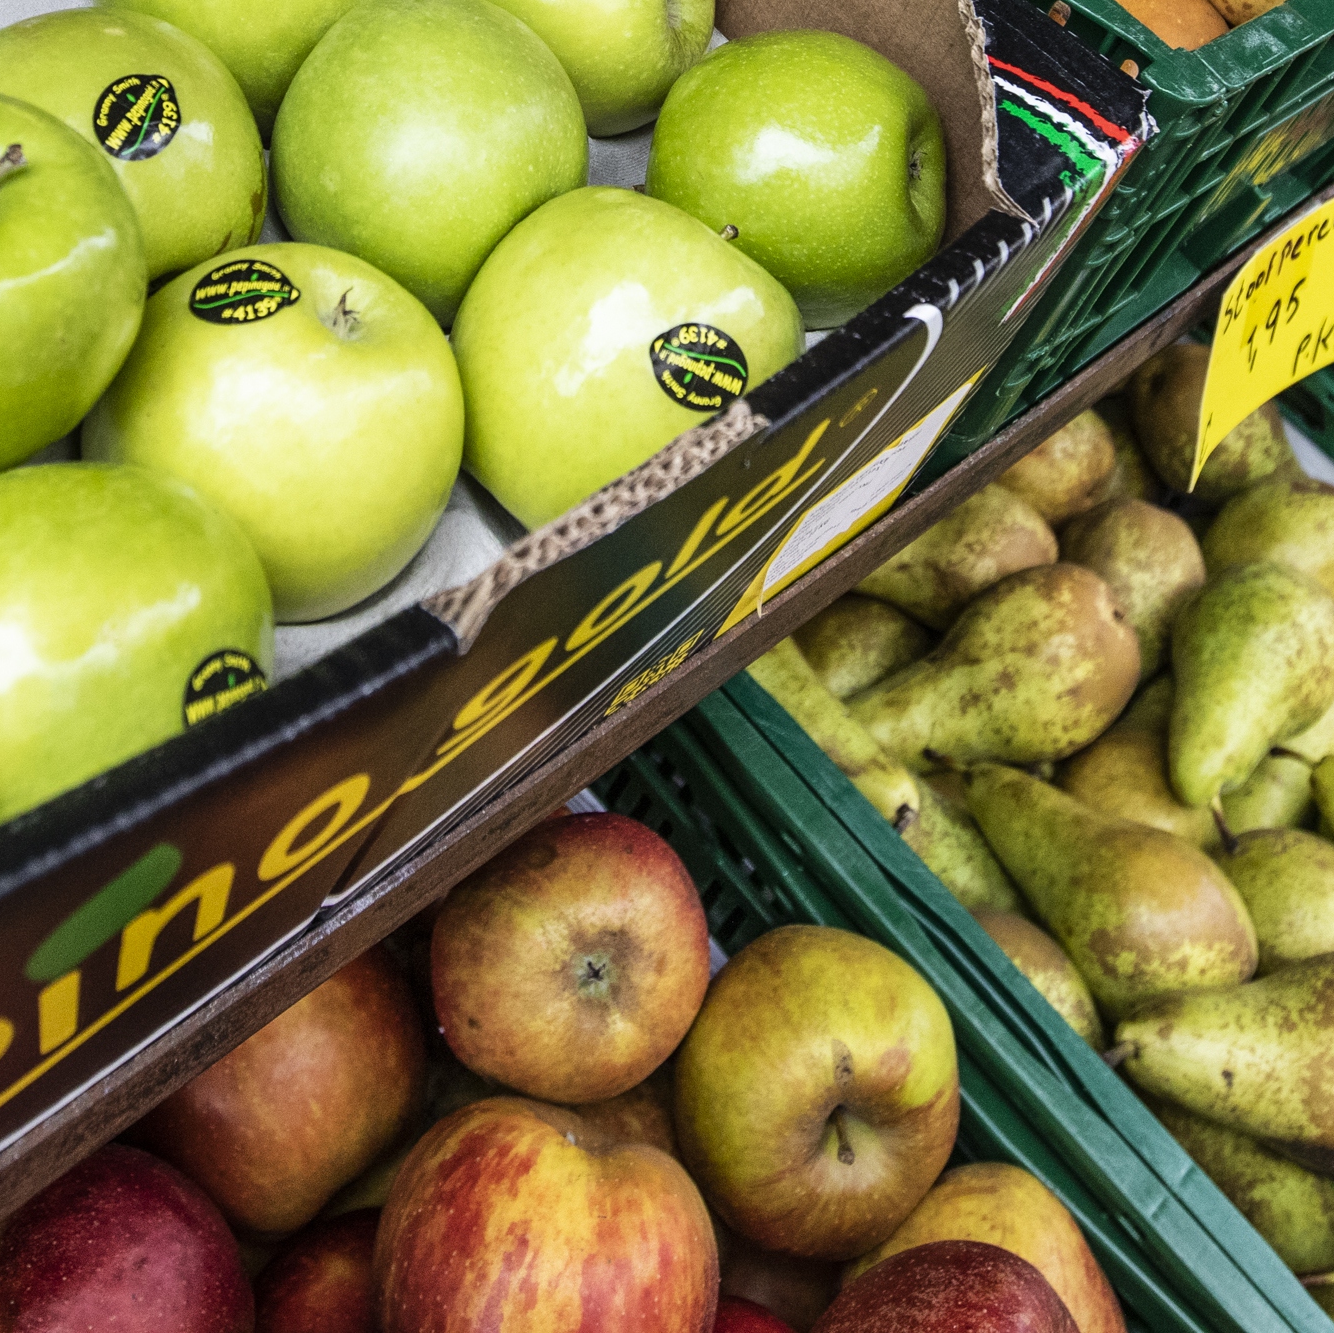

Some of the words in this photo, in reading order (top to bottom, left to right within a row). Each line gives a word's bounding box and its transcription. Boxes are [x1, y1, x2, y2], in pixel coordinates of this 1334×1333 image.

[96, 93, 117, 127] Granny
[112, 77, 141, 94] Smith
[211, 262, 250, 281] Granny
[251, 262, 282, 280] Smith
[661, 369, 687, 399] Smith
[686, 391, 722, 408] Granny
